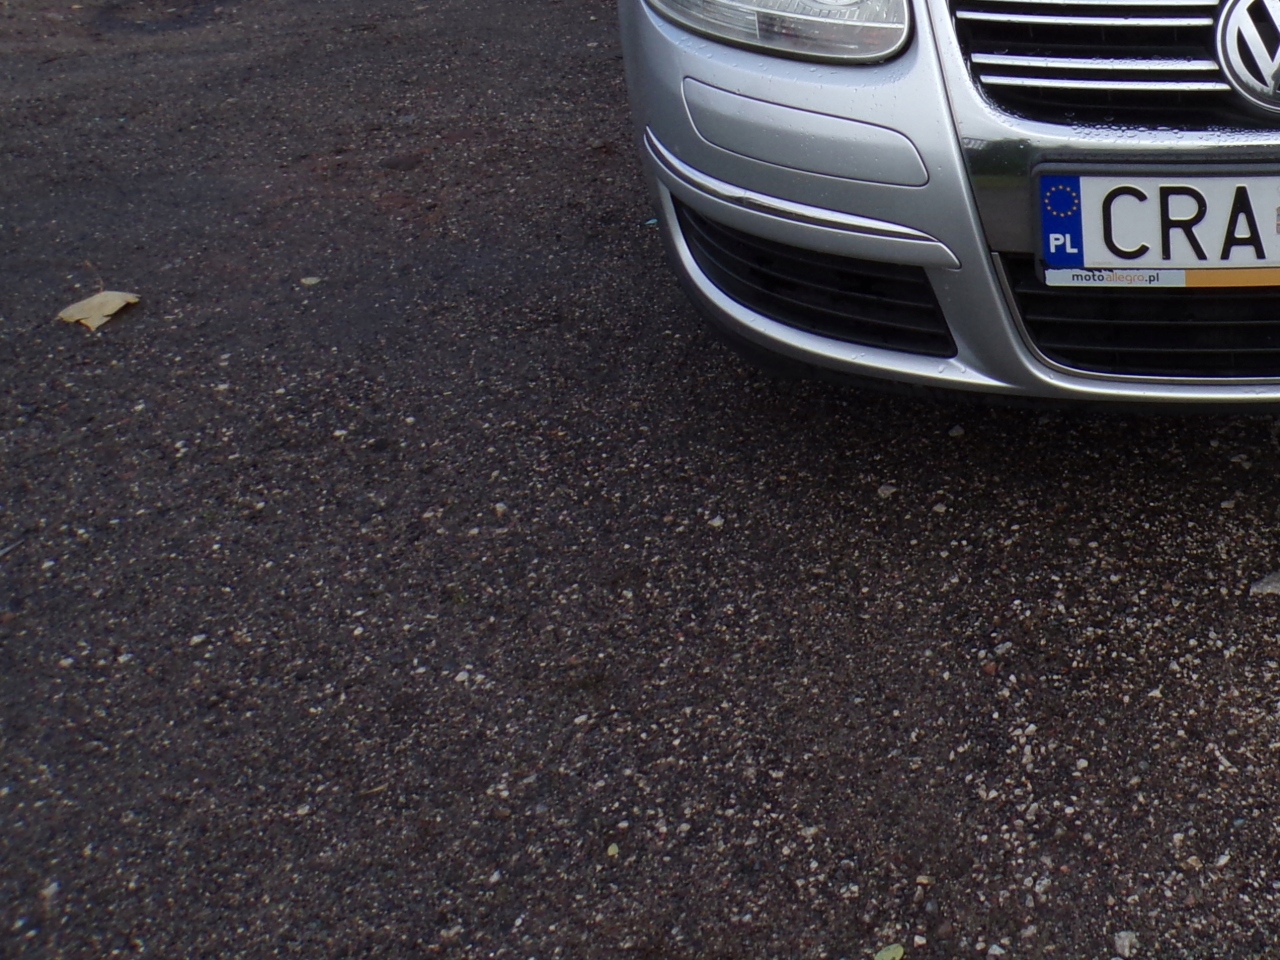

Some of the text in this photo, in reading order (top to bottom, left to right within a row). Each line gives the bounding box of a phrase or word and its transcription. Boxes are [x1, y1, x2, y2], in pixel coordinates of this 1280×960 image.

[1101, 185, 1267, 261] CRA
[1049, 233, 1079, 253] PL
[1072, 272, 1160, 285] motoallegro.pl
